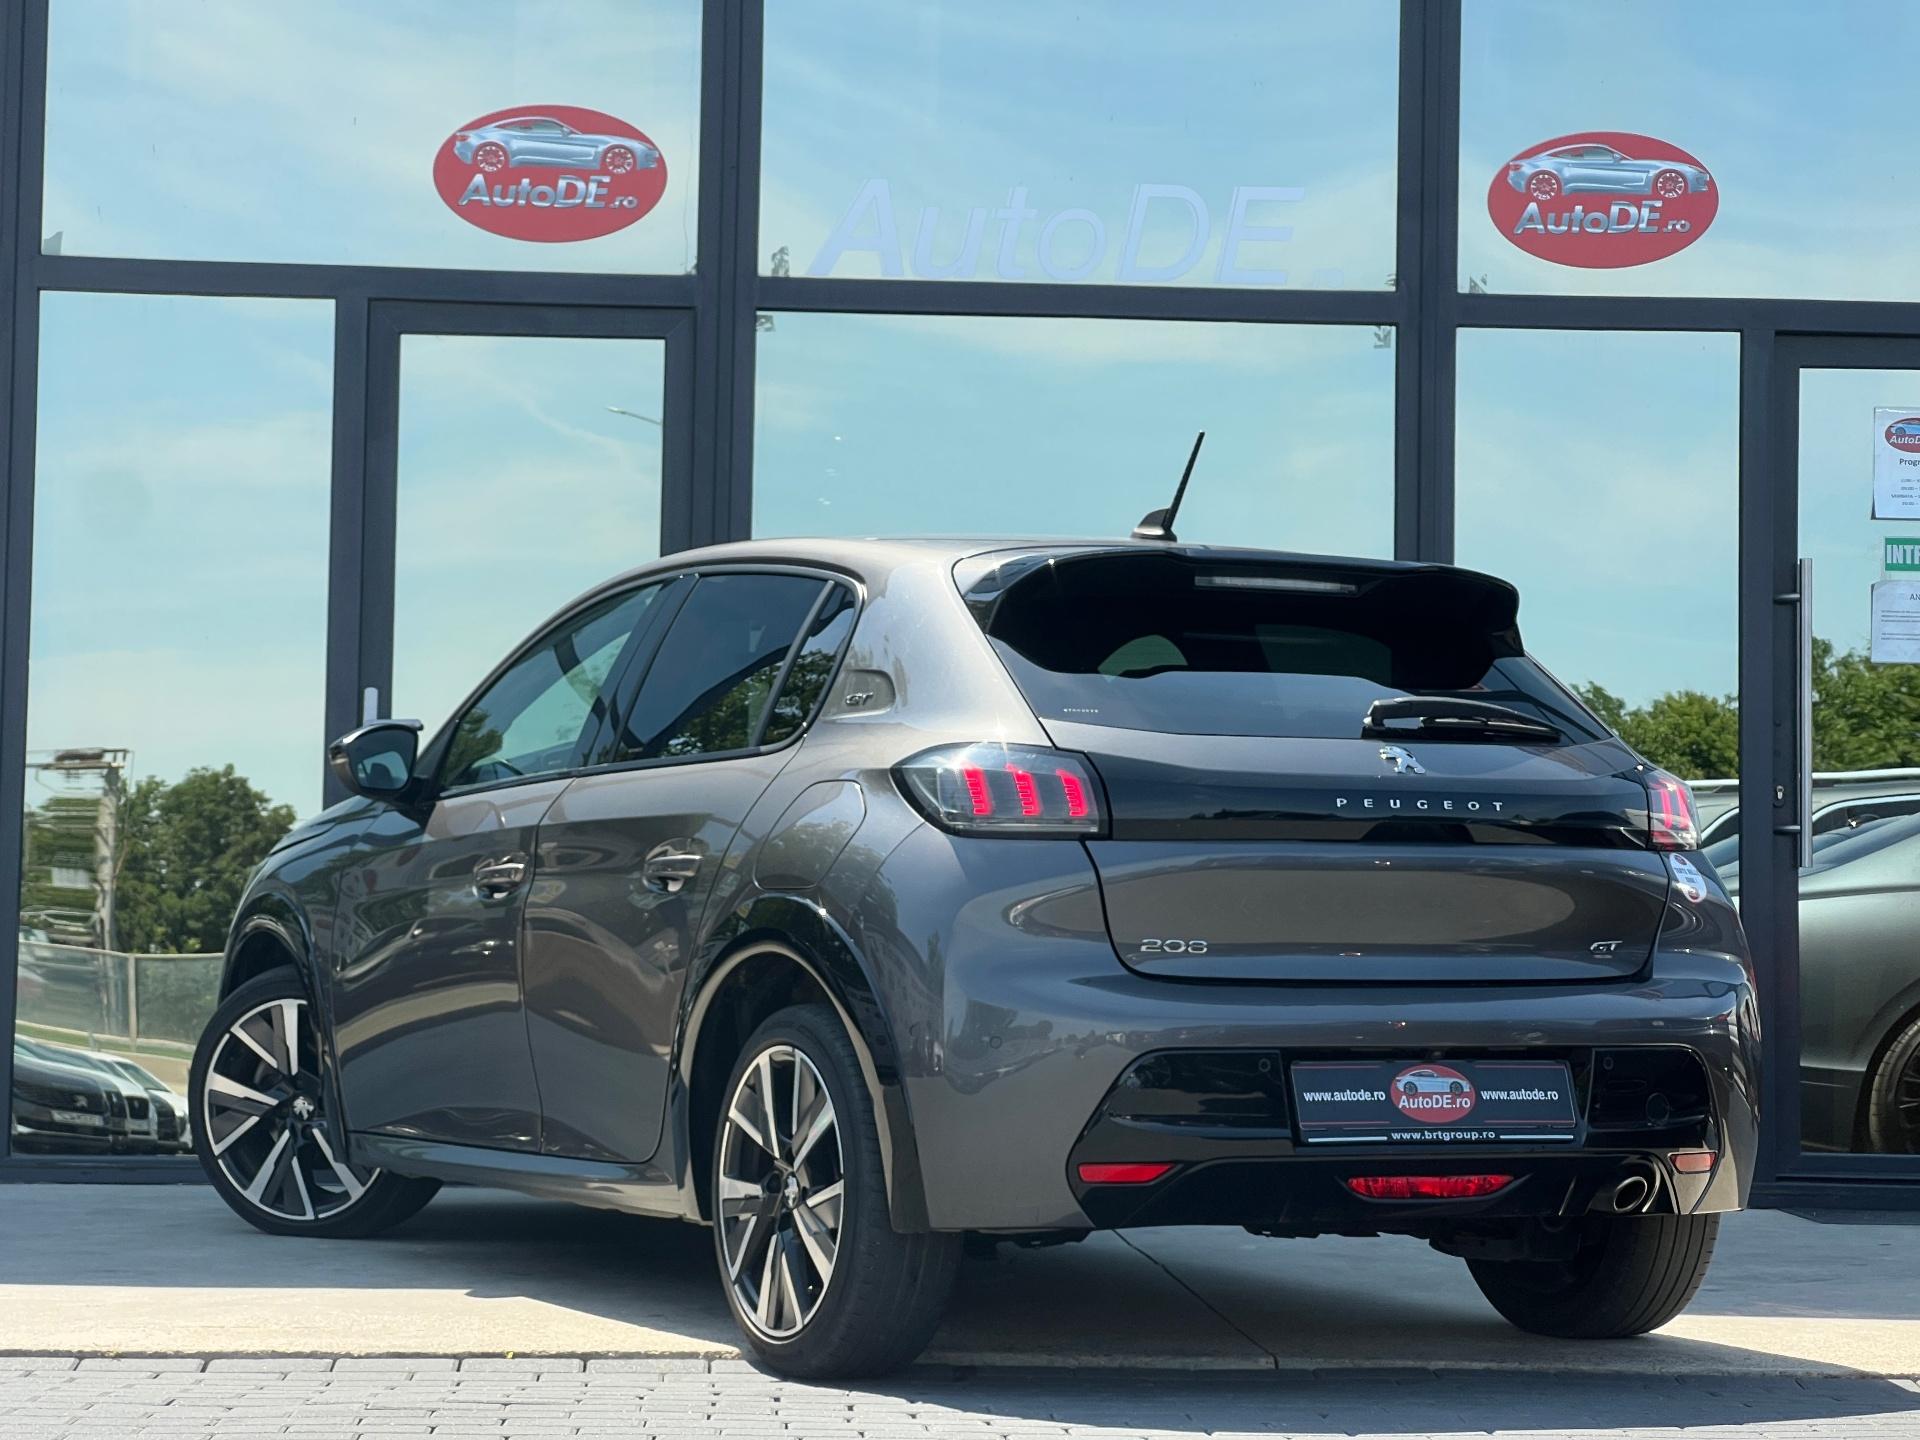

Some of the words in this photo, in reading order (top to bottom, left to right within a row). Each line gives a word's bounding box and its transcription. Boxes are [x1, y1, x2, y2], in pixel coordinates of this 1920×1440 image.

[1336, 798, 1503, 811] PEUGEOT
[1140, 938, 1208, 954] 208
[1590, 940, 1623, 954] GT
[1303, 1089, 1386, 1102] www.autode.ro
[1480, 1088, 1559, 1101] www.autode.ro
[1399, 1094, 1471, 1110] AutoDE.ro
[1391, 1130, 1496, 1142] www.brtgroup.ro
